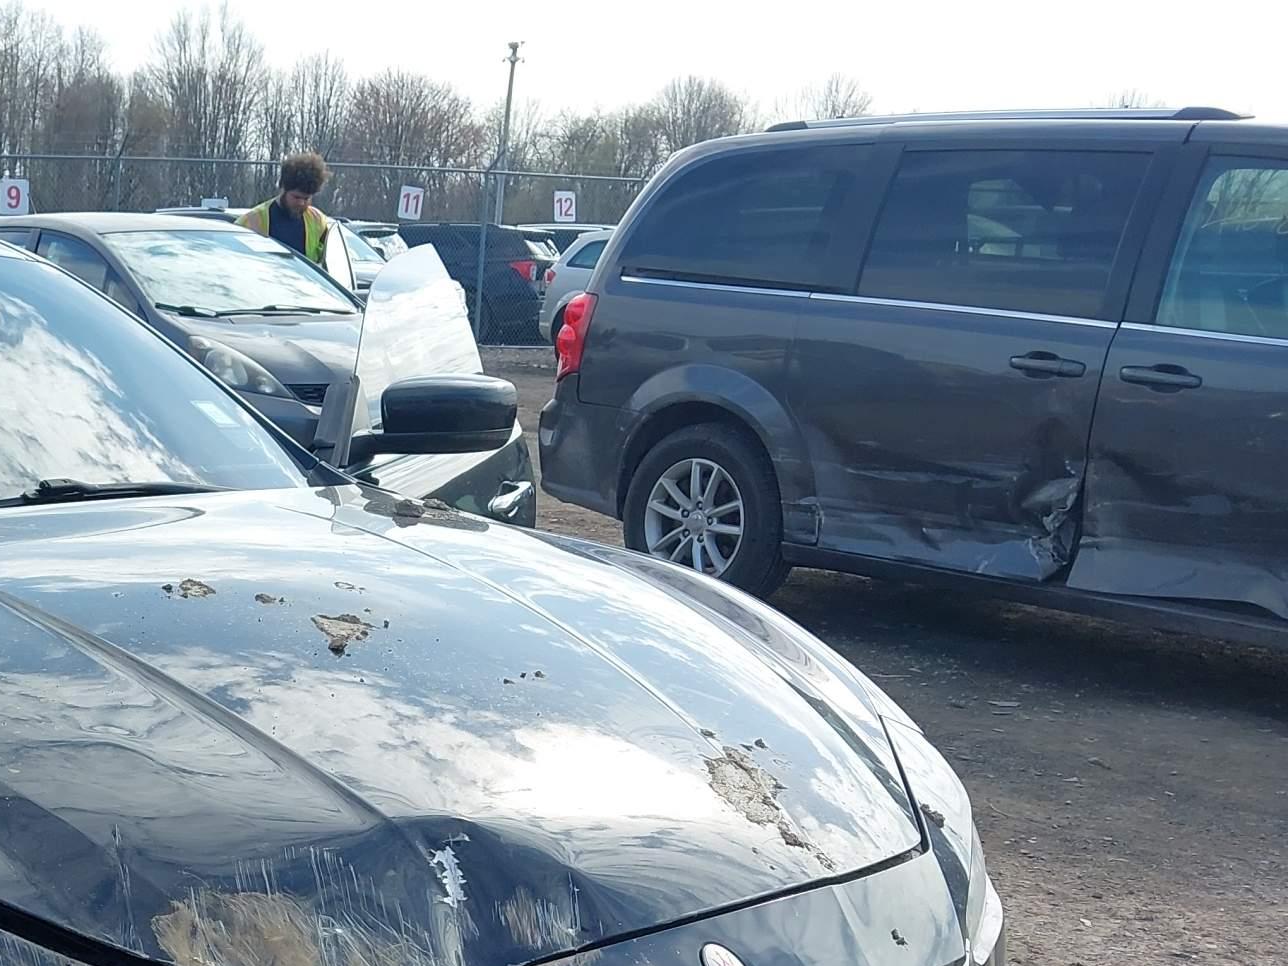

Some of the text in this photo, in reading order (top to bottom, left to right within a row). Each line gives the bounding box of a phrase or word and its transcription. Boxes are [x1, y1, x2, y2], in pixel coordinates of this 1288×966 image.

[6, 185, 21, 209] 9
[402, 192, 421, 215] 11
[555, 197, 574, 217] 12
